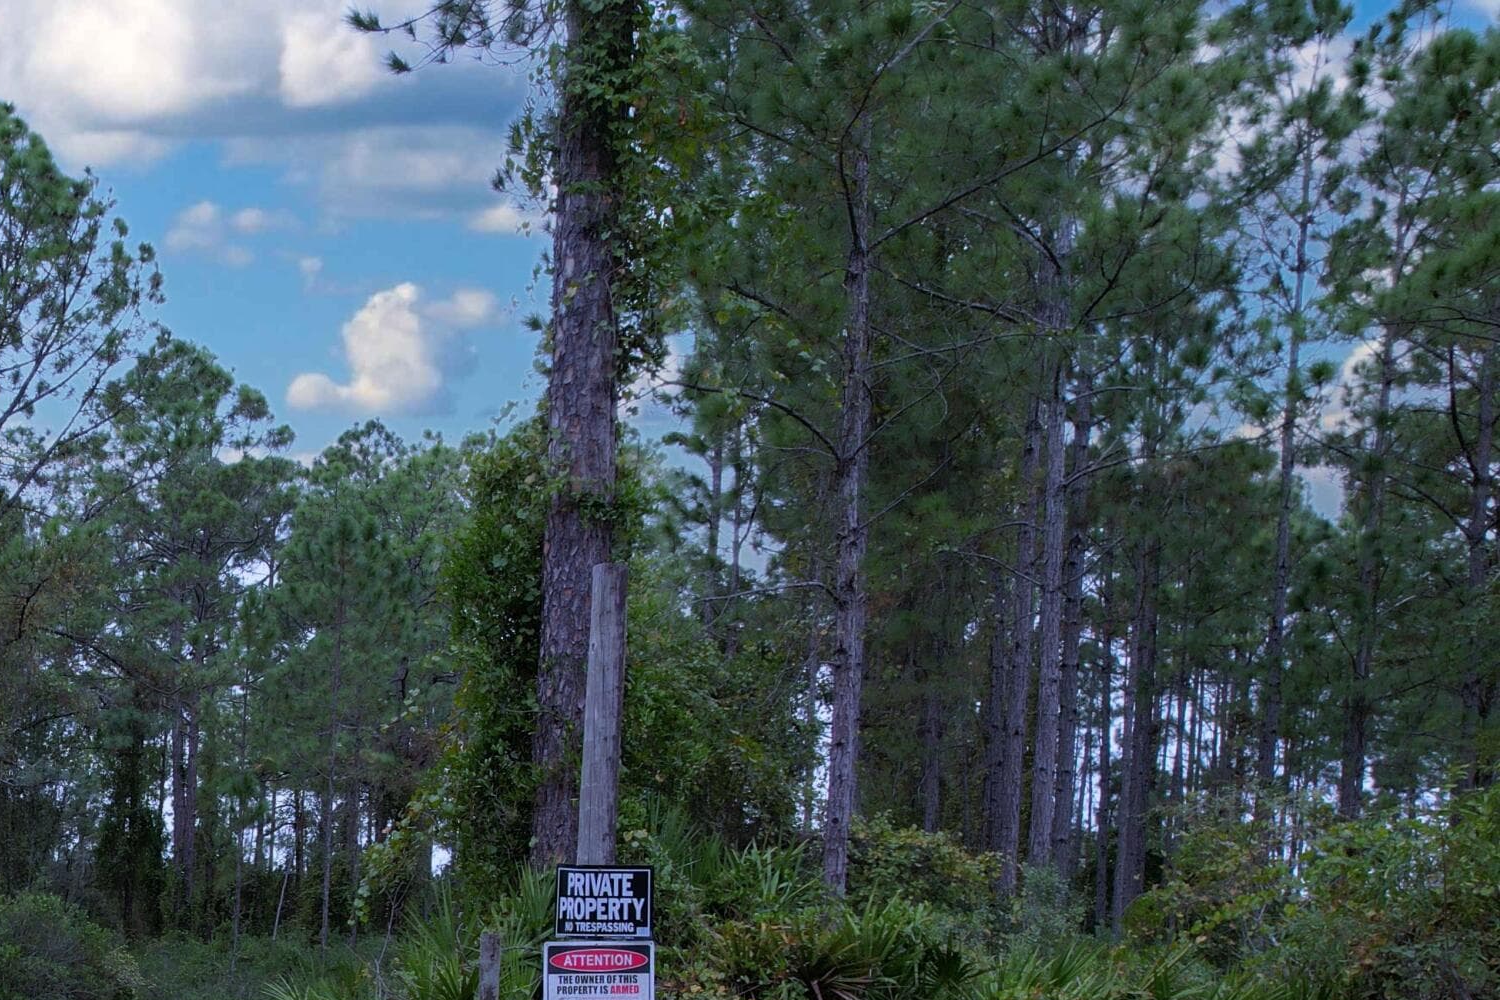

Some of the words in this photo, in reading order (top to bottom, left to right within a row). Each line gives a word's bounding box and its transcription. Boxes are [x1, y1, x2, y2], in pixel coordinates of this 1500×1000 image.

[567, 872, 634, 897] PRIVATE
[559, 896, 645, 921] PROPERTY
[564, 921, 574, 932] NO
[575, 921, 634, 933] TRESPASSING
[563, 954, 633, 967] ATTENTION
[558, 975, 573, 985] THE
[574, 975, 605, 985] OWNER
[606, 974, 617, 985] OF
[618, 974, 638, 984] THIS
[556, 985, 598, 995] PROPERTY
[599, 985, 609, 995] IS
[609, 984, 640, 995] ARMED
